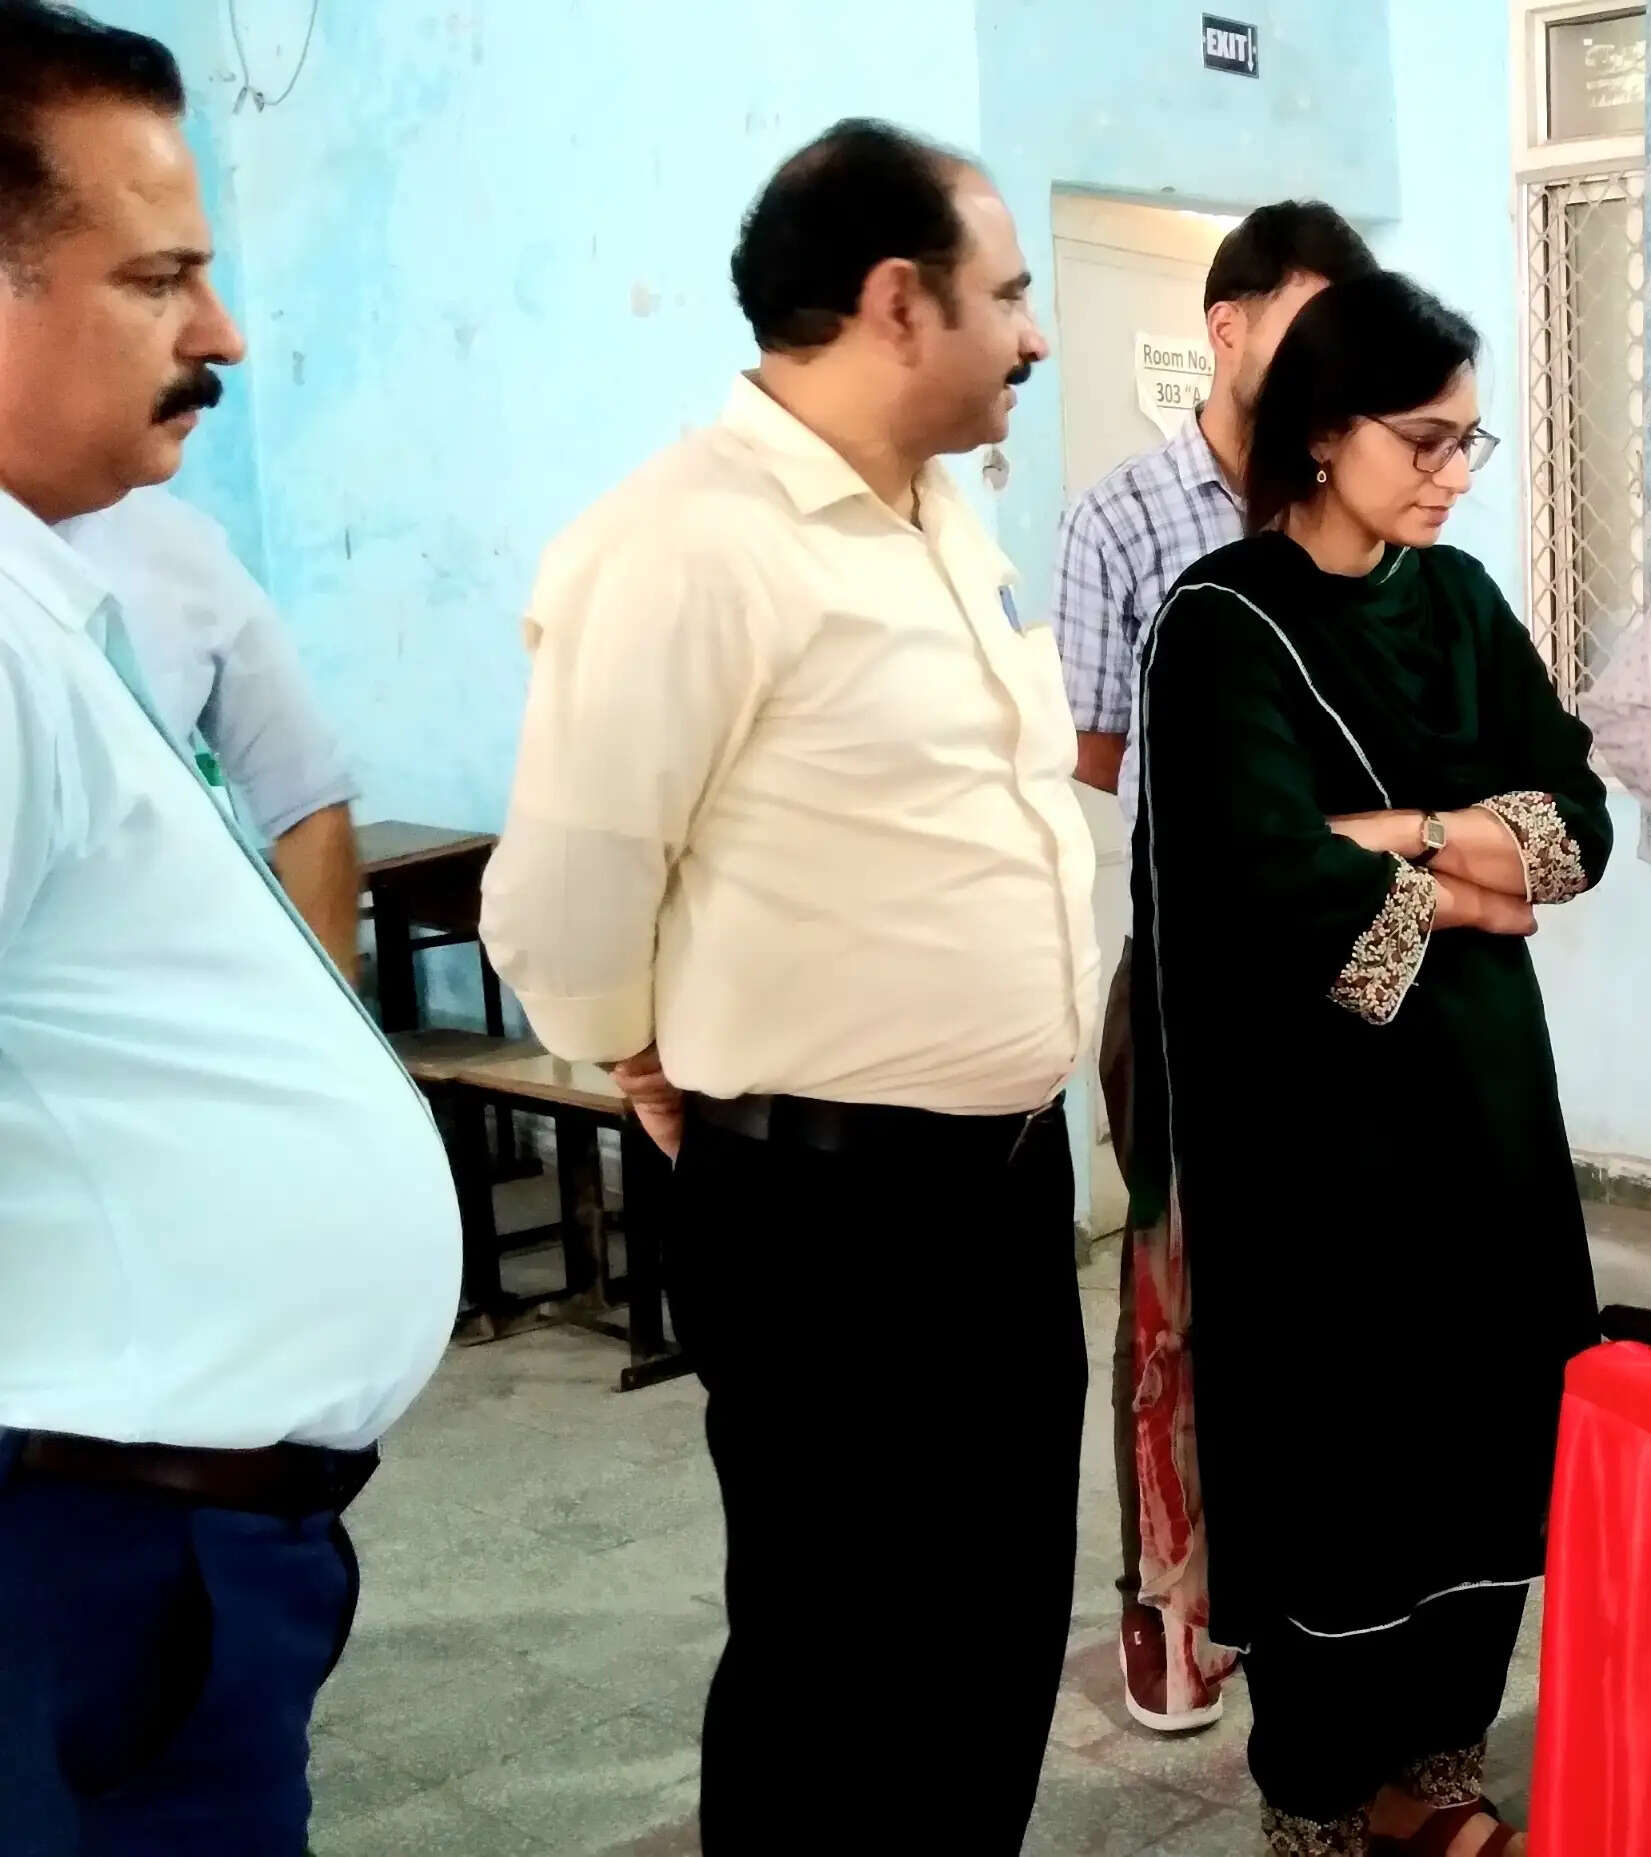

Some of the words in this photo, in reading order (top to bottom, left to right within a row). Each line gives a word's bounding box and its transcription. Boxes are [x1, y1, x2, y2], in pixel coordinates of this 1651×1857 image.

[1206, 27, 1248, 62] EXIT
[1143, 343, 1184, 368] Room
[1188, 350, 1212, 372] No.
[1156, 382, 1181, 404] 303
